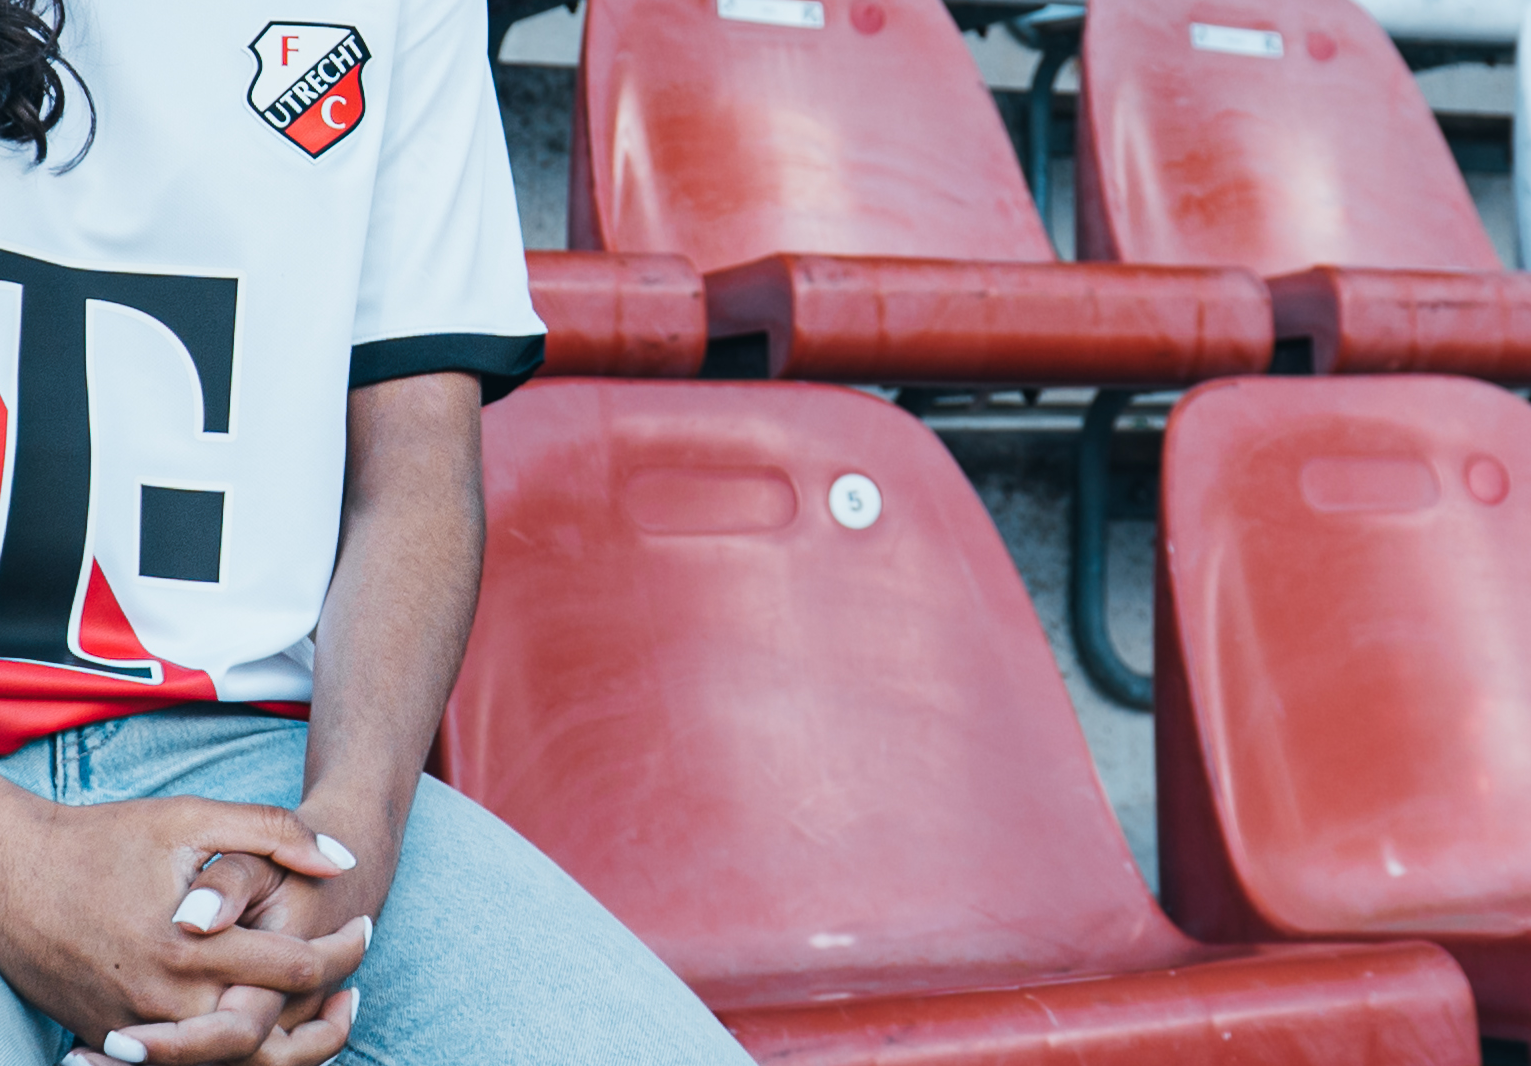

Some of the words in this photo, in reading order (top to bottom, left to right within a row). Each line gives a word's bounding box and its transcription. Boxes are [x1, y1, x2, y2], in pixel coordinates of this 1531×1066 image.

[281, 35, 299, 67] F
[264, 34, 363, 129] UTRECHT
[321, 95, 347, 130] C
[847, 489, 864, 513] 5
